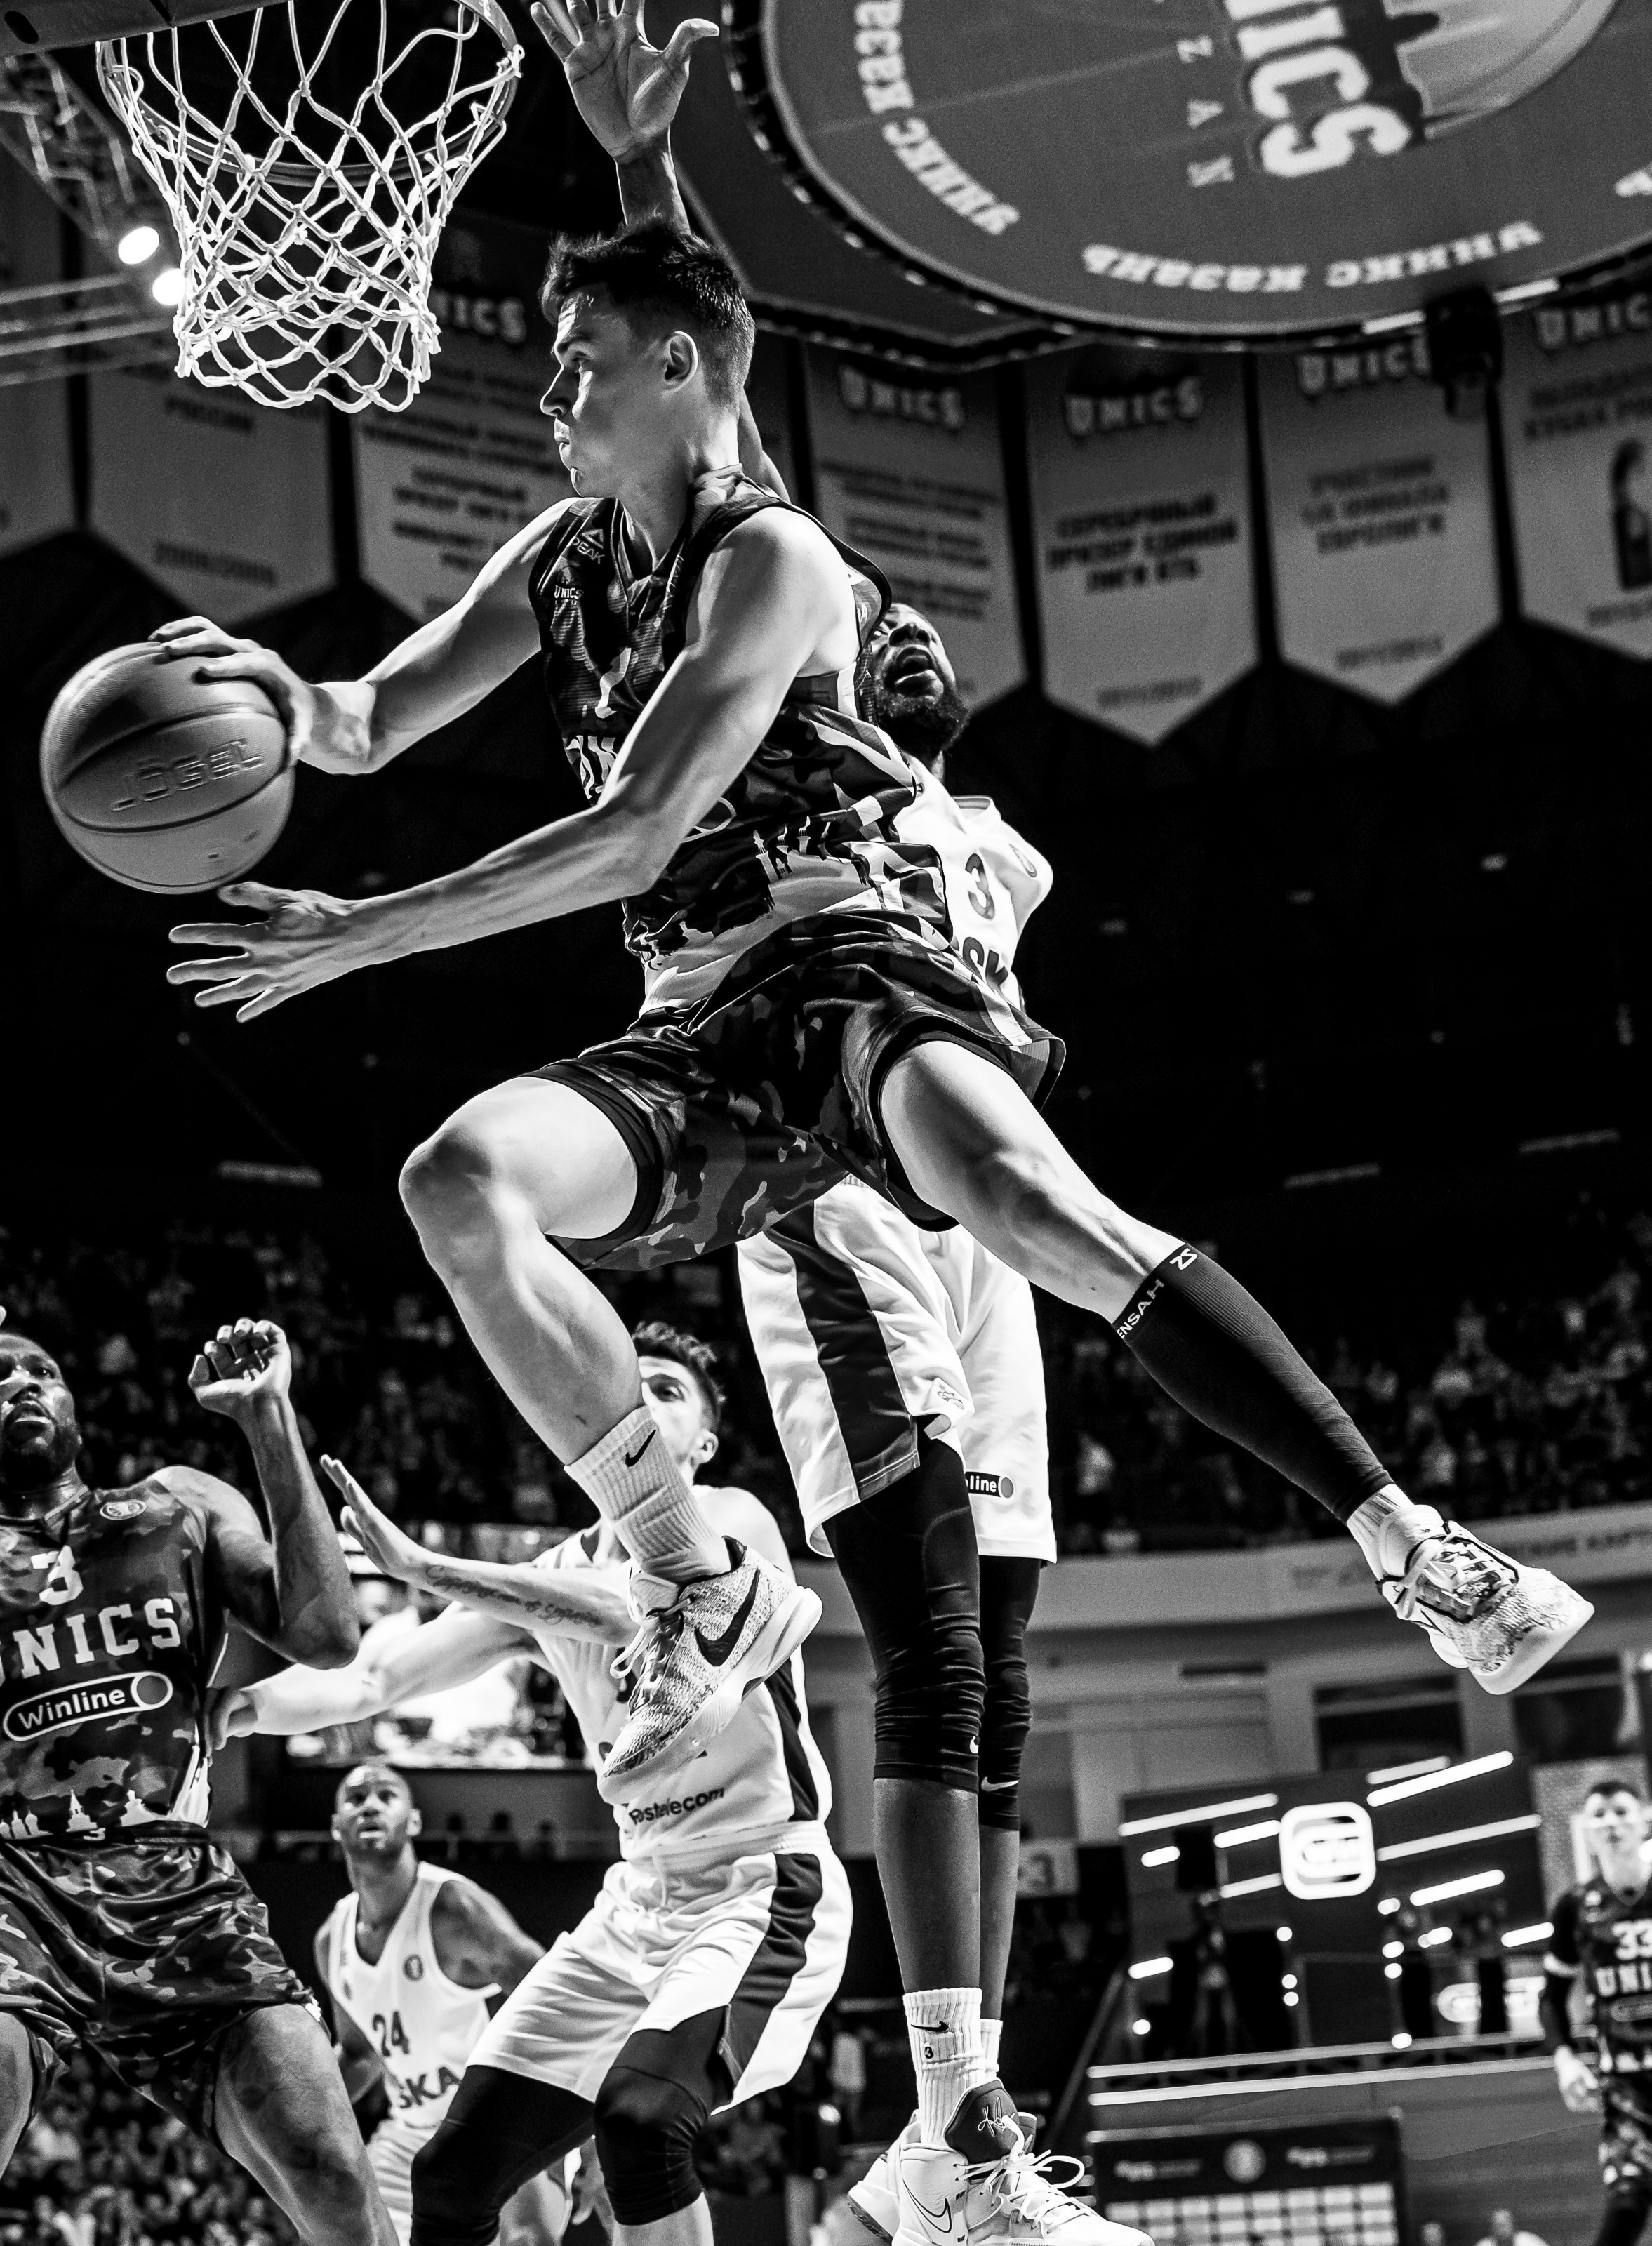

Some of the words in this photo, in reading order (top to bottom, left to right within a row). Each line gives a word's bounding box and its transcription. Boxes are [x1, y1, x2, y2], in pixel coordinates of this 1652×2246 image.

[1224, 0, 1411, 178] ICS
[571, 536, 606, 564] PEAK
[554, 585, 584, 599] UNICS
[964, 852, 995, 921] 3
[965, 1475, 997, 1494] line
[30, 1544, 84, 1606] 3
[0, 1597, 181, 1686] NICS
[18, 1688, 126, 1730] Winline
[372, 2010, 410, 2057] 24
[924, 2045, 934, 2059] 3
